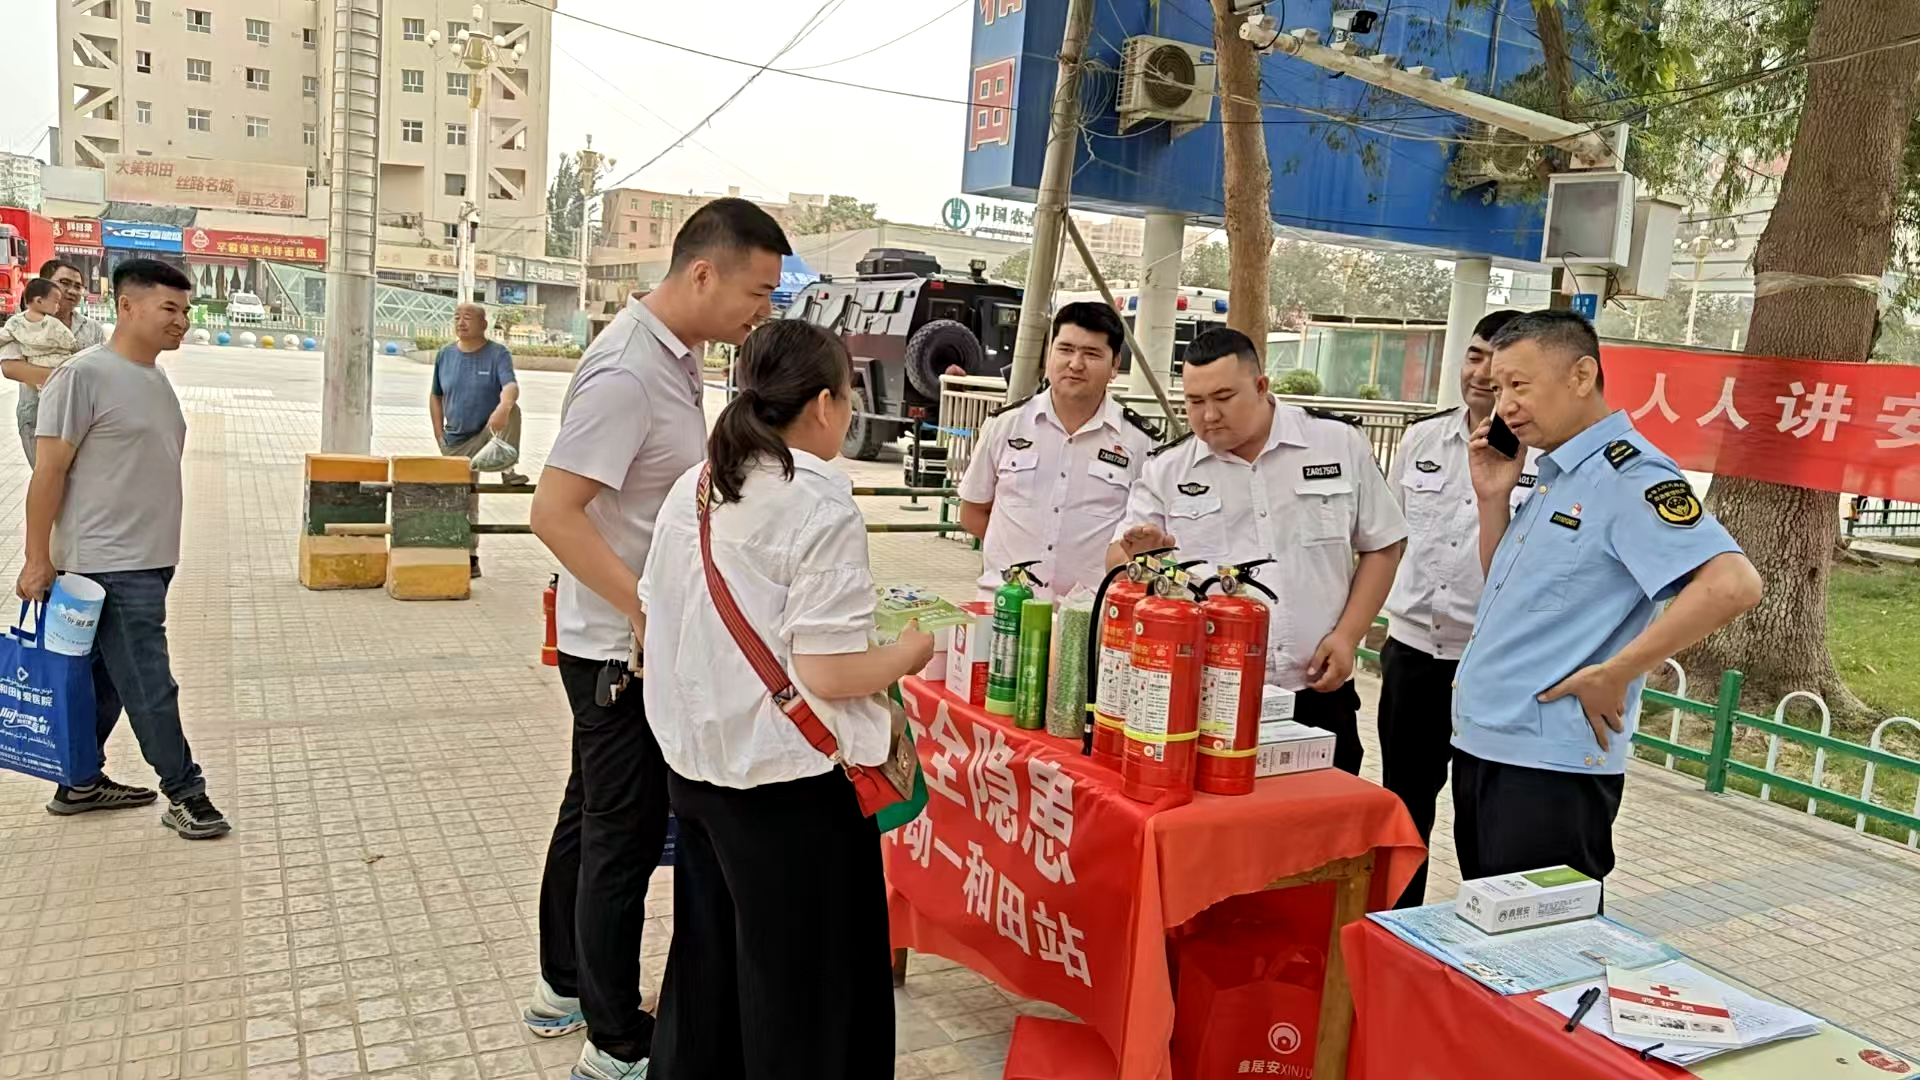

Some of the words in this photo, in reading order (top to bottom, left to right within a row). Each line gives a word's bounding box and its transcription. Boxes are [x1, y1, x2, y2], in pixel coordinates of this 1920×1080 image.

[115, 160, 174, 178] 大美和田
[176, 176, 234, 194] 丝路名城
[236, 191, 296, 209] 国玉之都
[1631, 372, 1920, 449] 人人讲安
[1305, 465, 1340, 477] ZA017501
[1641, 996, 1696, 1013] 救护员
[1238, 1060, 1280, 1075] 鑫居安
